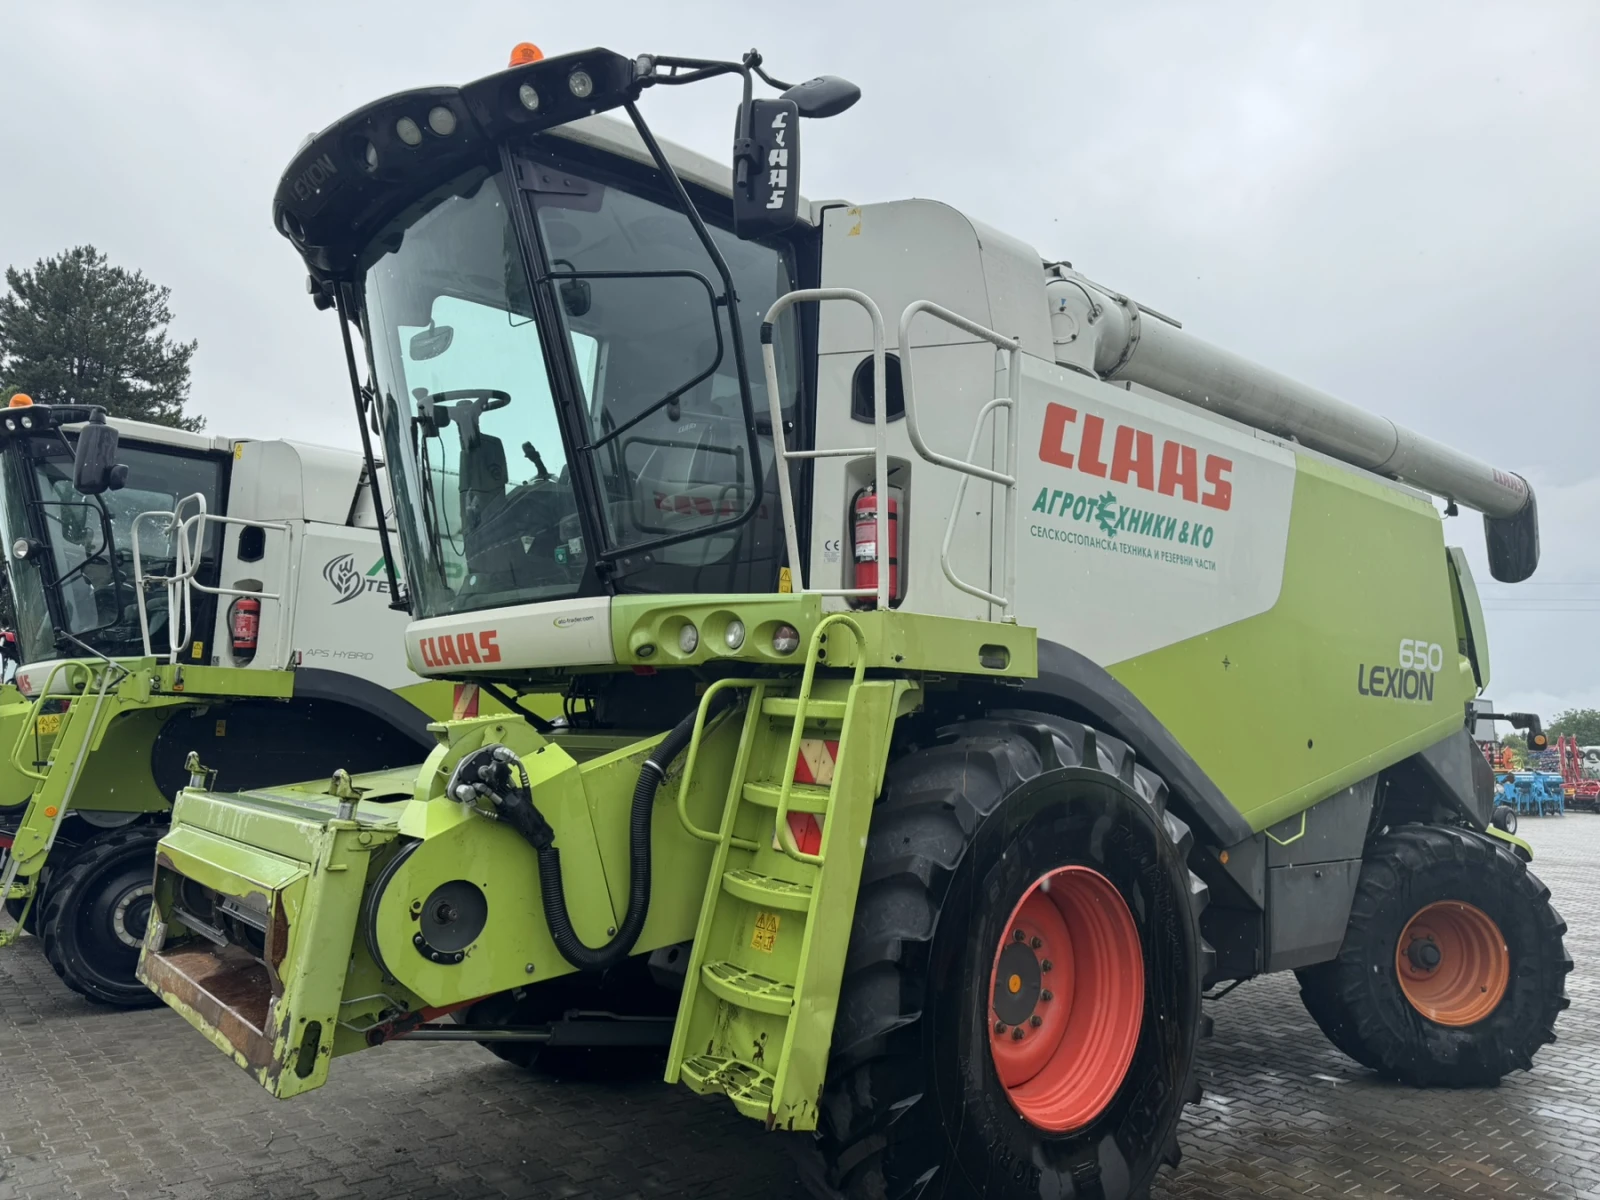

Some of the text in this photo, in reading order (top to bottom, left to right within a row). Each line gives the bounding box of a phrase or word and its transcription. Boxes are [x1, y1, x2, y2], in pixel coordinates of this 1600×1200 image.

[1038, 401, 1233, 512] CLAAS
[1030, 525, 1118, 552] СЕЛСКОСТОПАНСКА
[1119, 542, 1152, 559] ТЕХНИКА
[1161, 551, 1193, 567] РЕЗЕРВНИ
[1194, 558, 1216, 571] ЧАСТИ
[305, 648, 374, 660] APS HYBRID
[419, 630, 502, 668] CLAAS
[1399, 638, 1443, 672] 650
[1358, 663, 1434, 701] LEXION
